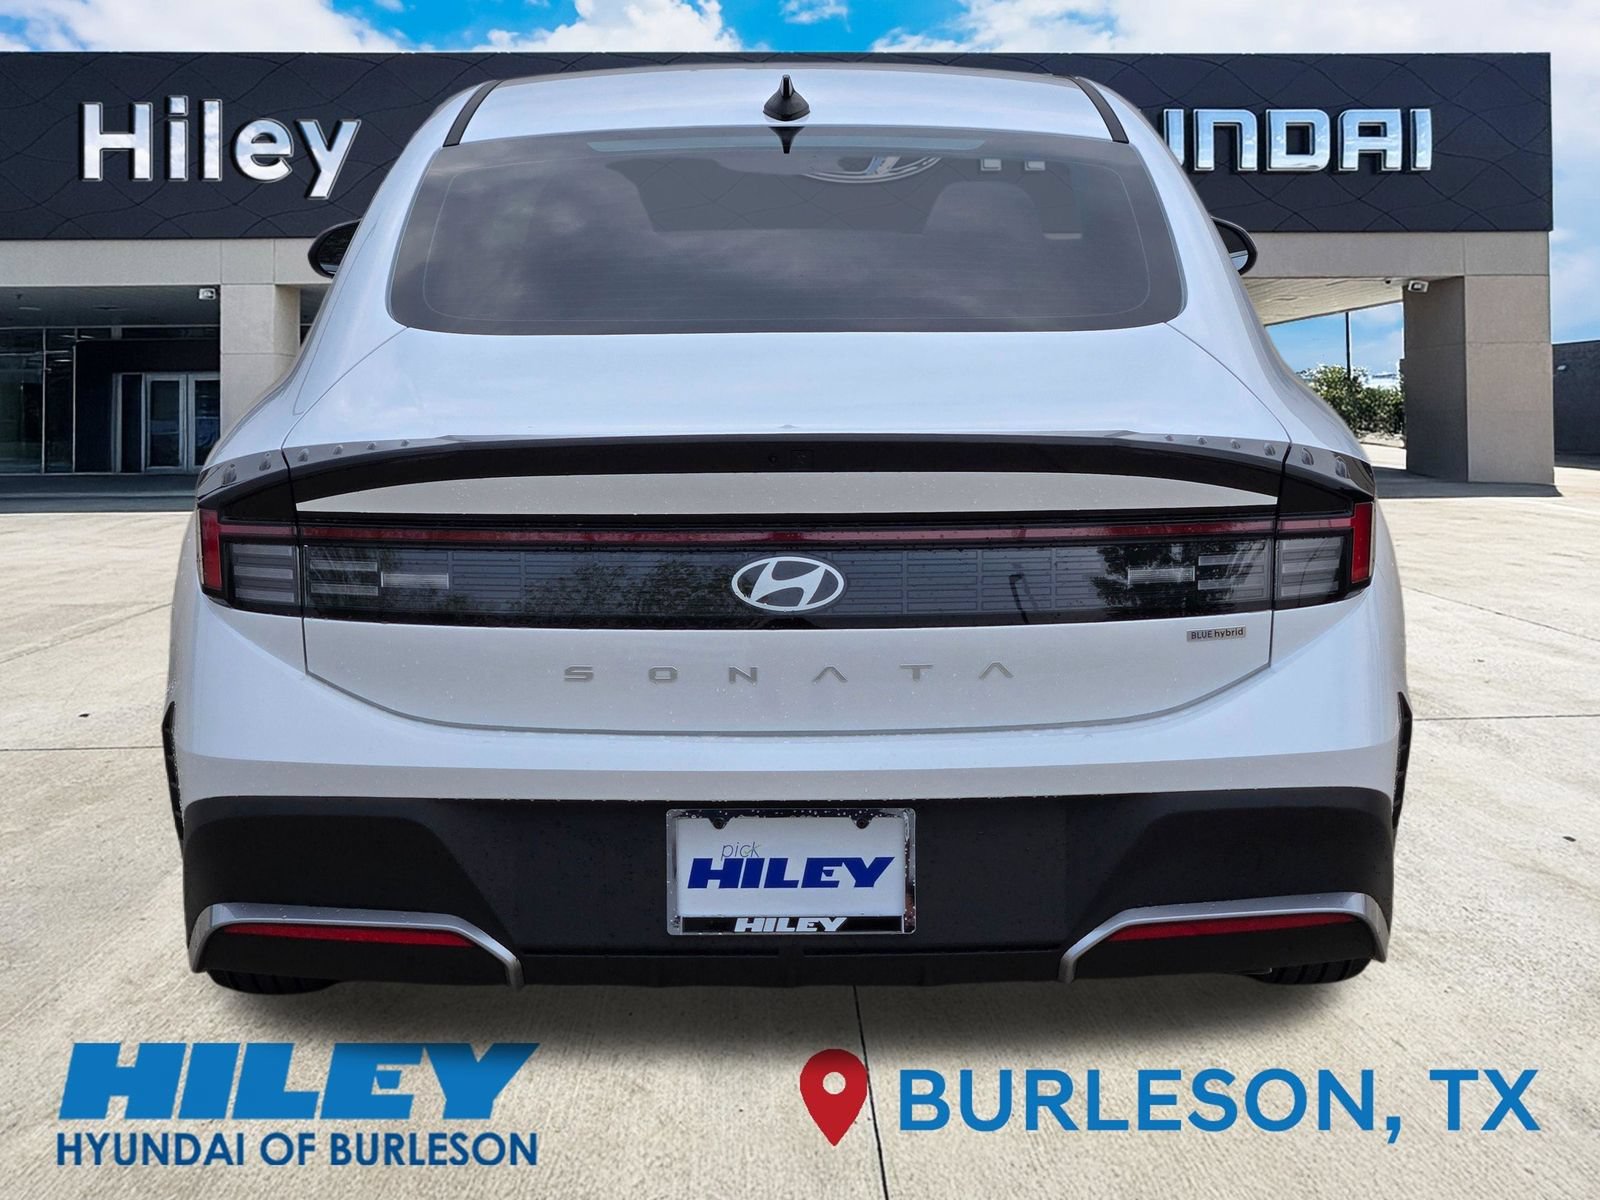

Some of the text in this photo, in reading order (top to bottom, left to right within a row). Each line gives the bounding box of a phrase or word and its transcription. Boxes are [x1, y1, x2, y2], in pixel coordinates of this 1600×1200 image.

[80, 95, 361, 199] Hiley
[1190, 627, 1244, 640] BLUE hybrid
[563, 660, 1015, 684] SONATA
[720, 841, 761, 861] pick
[687, 856, 896, 889] HILEY
[733, 917, 848, 933] HILEY
